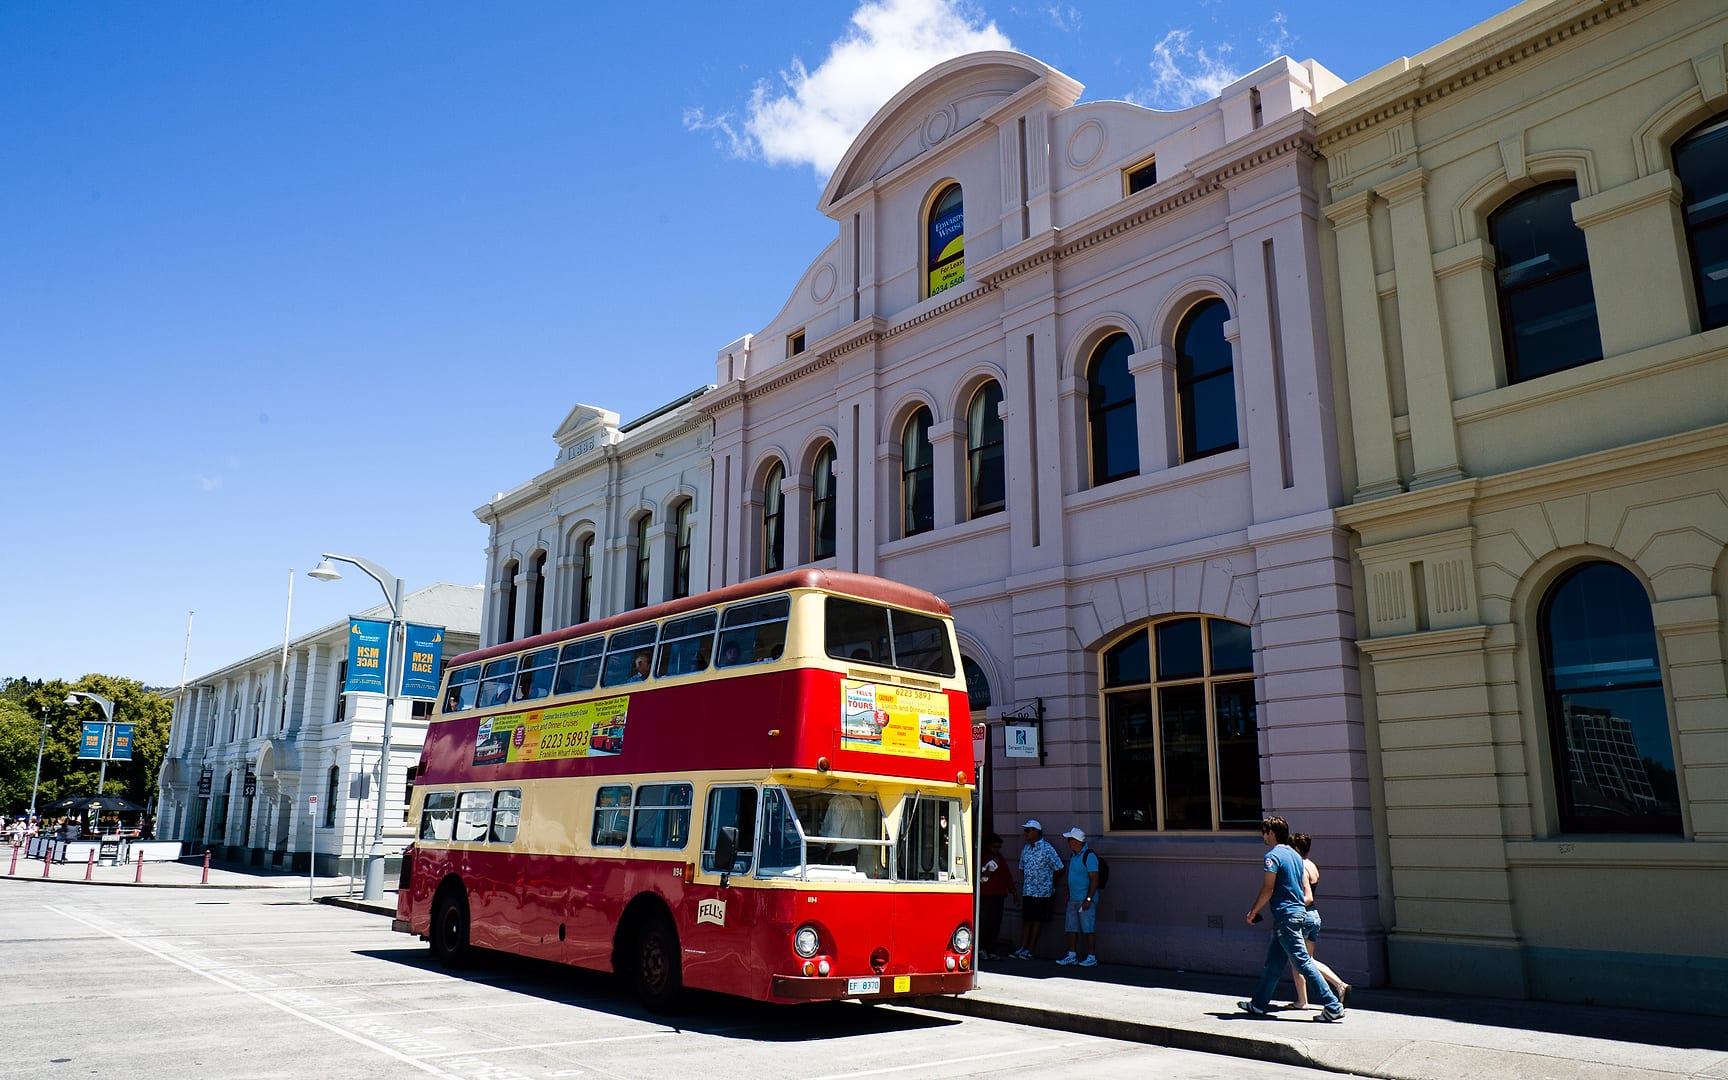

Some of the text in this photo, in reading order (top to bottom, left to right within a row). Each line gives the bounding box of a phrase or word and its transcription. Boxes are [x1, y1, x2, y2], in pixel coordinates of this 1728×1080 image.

[939, 222, 964, 238] WINDSO
[940, 266, 949, 275] For
[412, 652, 434, 664] M2H
[412, 662, 432, 673] RACE
[896, 688, 932, 700] 6223 5893
[848, 700, 874, 710] TOURS
[882, 702, 946, 717] Lunch and Dinner Cruises
[528, 724, 540, 732] Lunch
[541, 733, 563, 749] 6223
[565, 730, 588, 747] 5893
[862, 982, 878, 990] 8370
